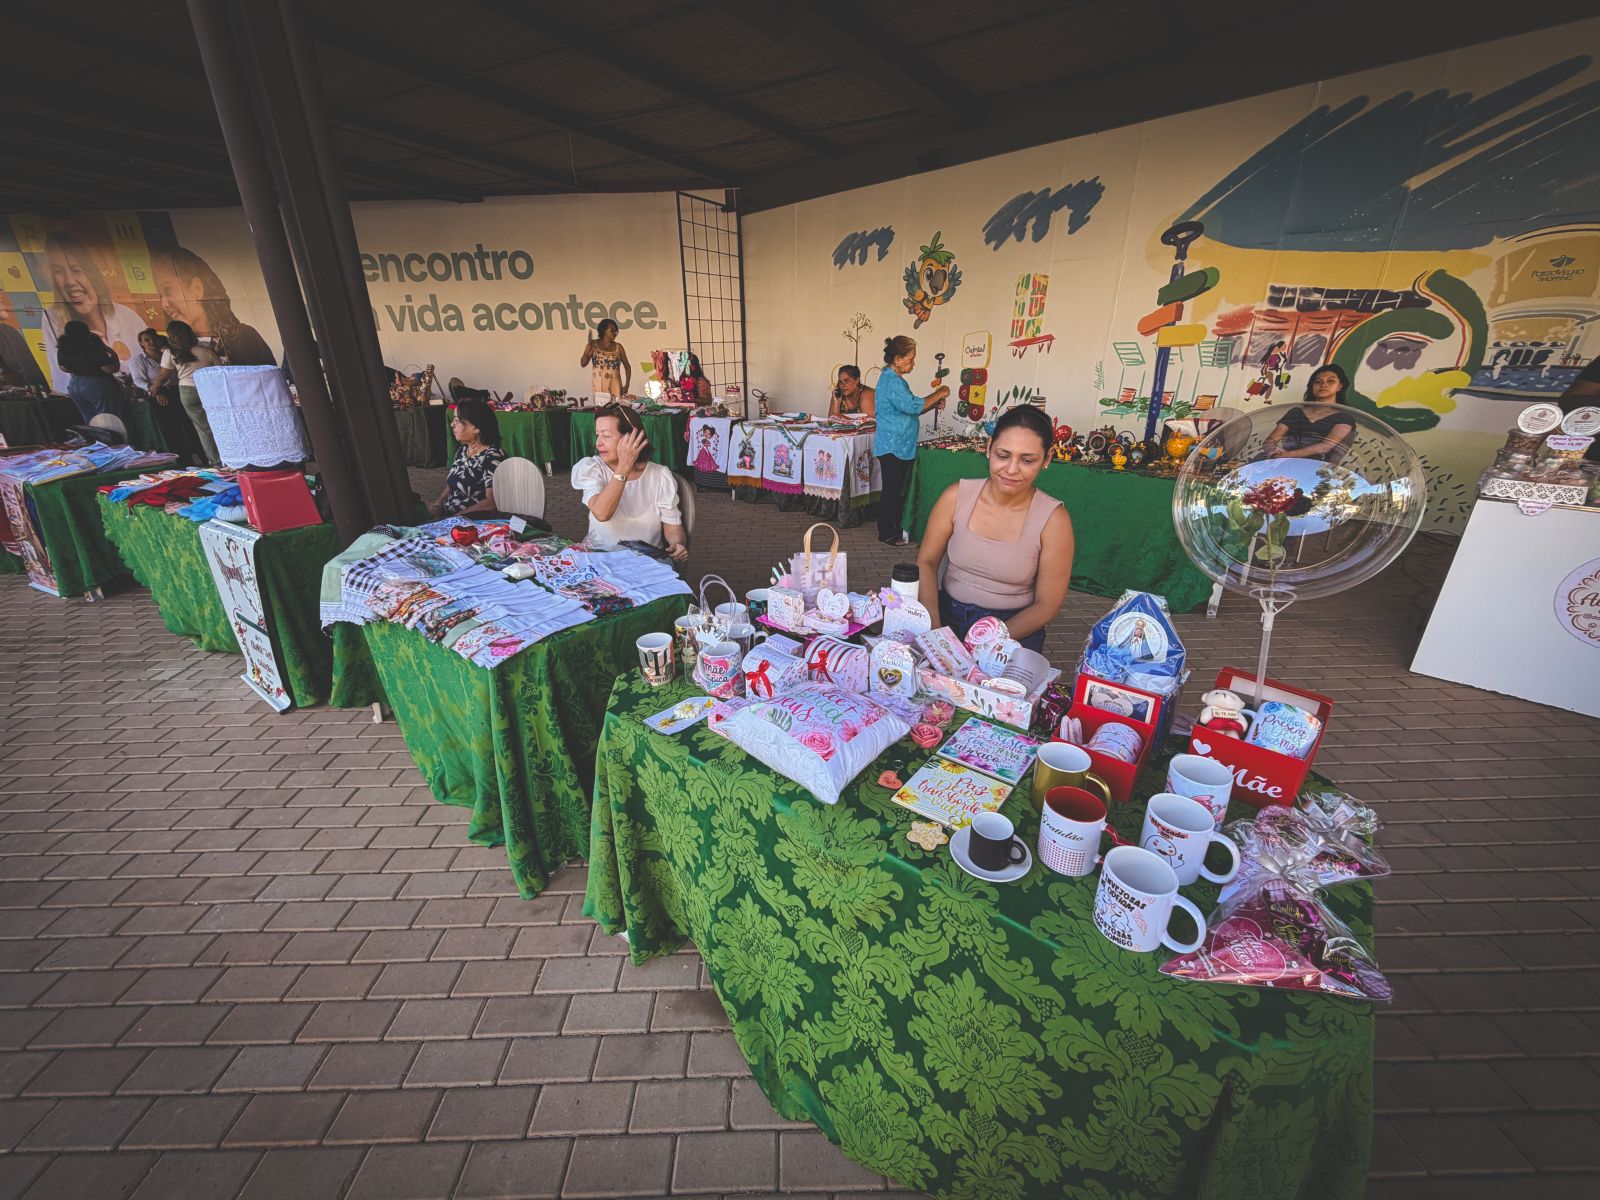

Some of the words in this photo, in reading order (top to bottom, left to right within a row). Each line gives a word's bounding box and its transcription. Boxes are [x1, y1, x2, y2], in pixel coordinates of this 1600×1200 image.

[359, 243, 535, 283] encontro
[385, 294, 465, 333] vida
[471, 293, 667, 332] acontece.
